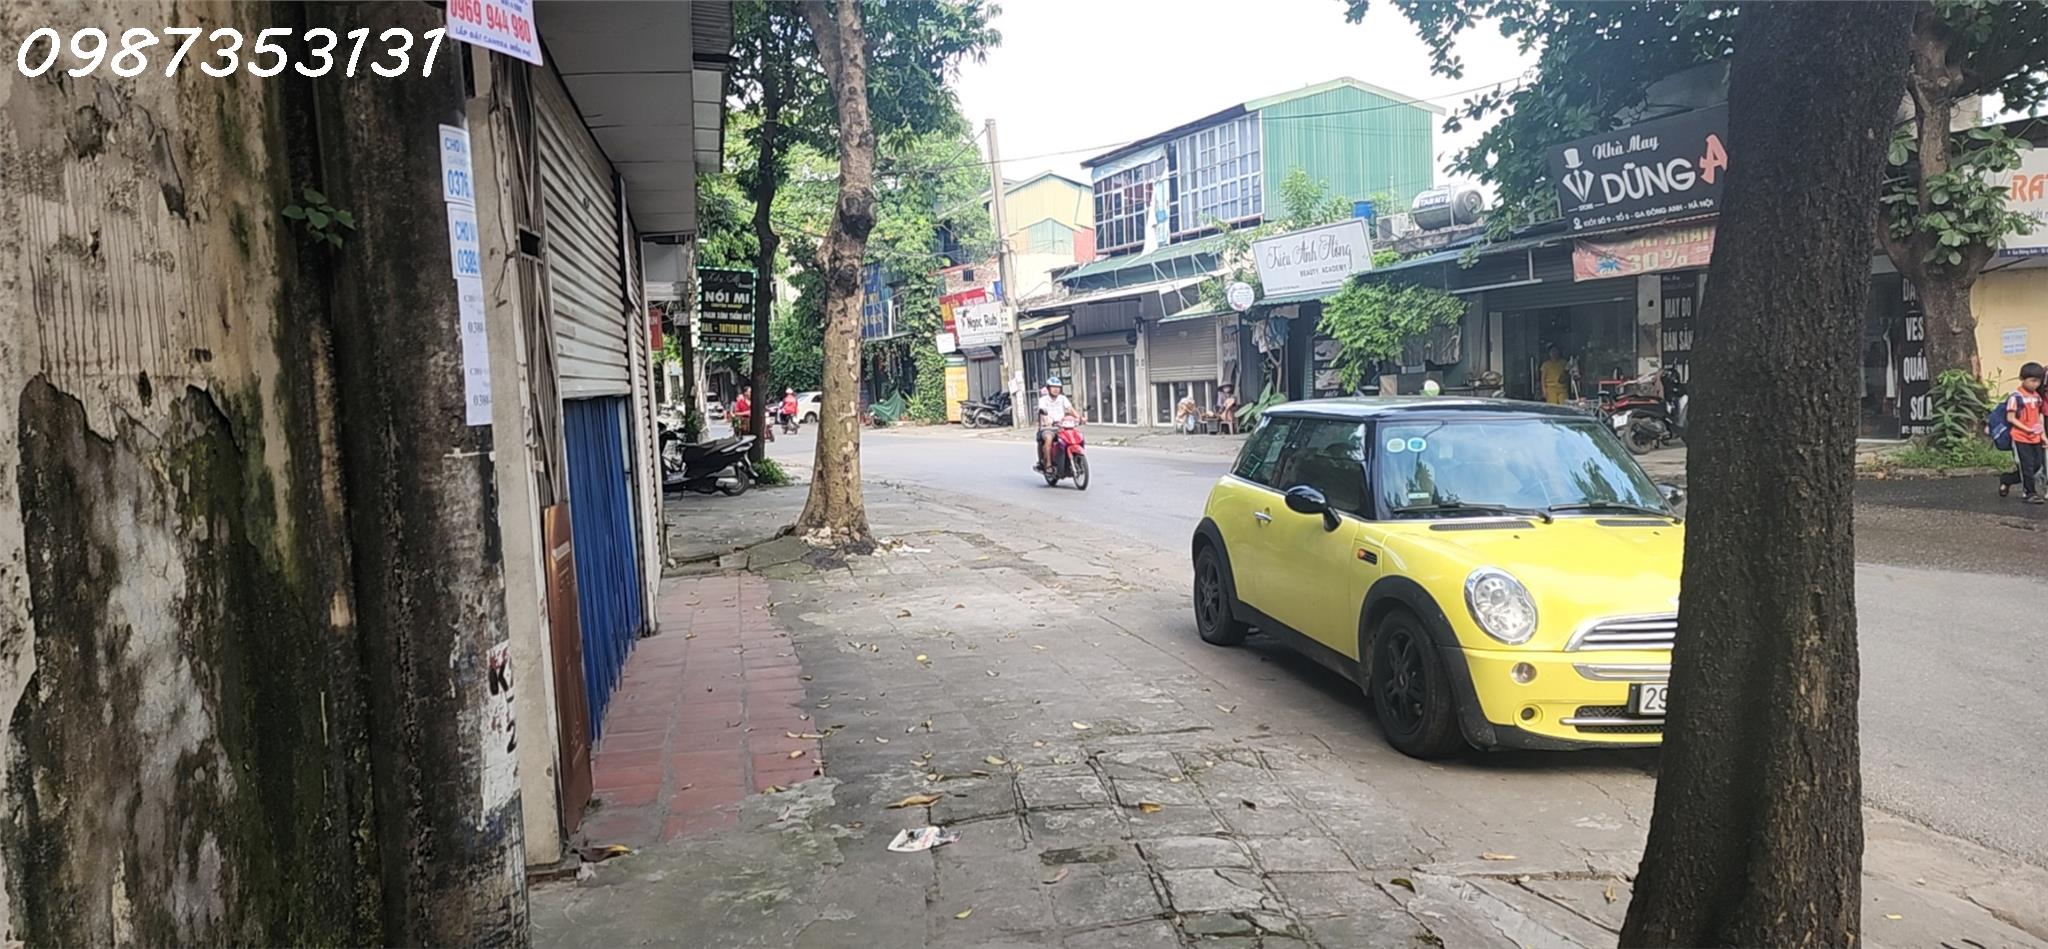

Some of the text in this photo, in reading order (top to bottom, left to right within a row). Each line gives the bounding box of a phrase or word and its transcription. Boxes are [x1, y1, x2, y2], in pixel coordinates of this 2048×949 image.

[486, 3, 509, 34] 944
[511, 13, 531, 43] 980
[1592, 134, 1660, 159] Nhà May
[1600, 157, 1696, 204] DŨNG
[2011, 174, 2048, 202] RA
[1322, 264, 1347, 273] ACADEMY
[734, 293, 750, 303] MI
